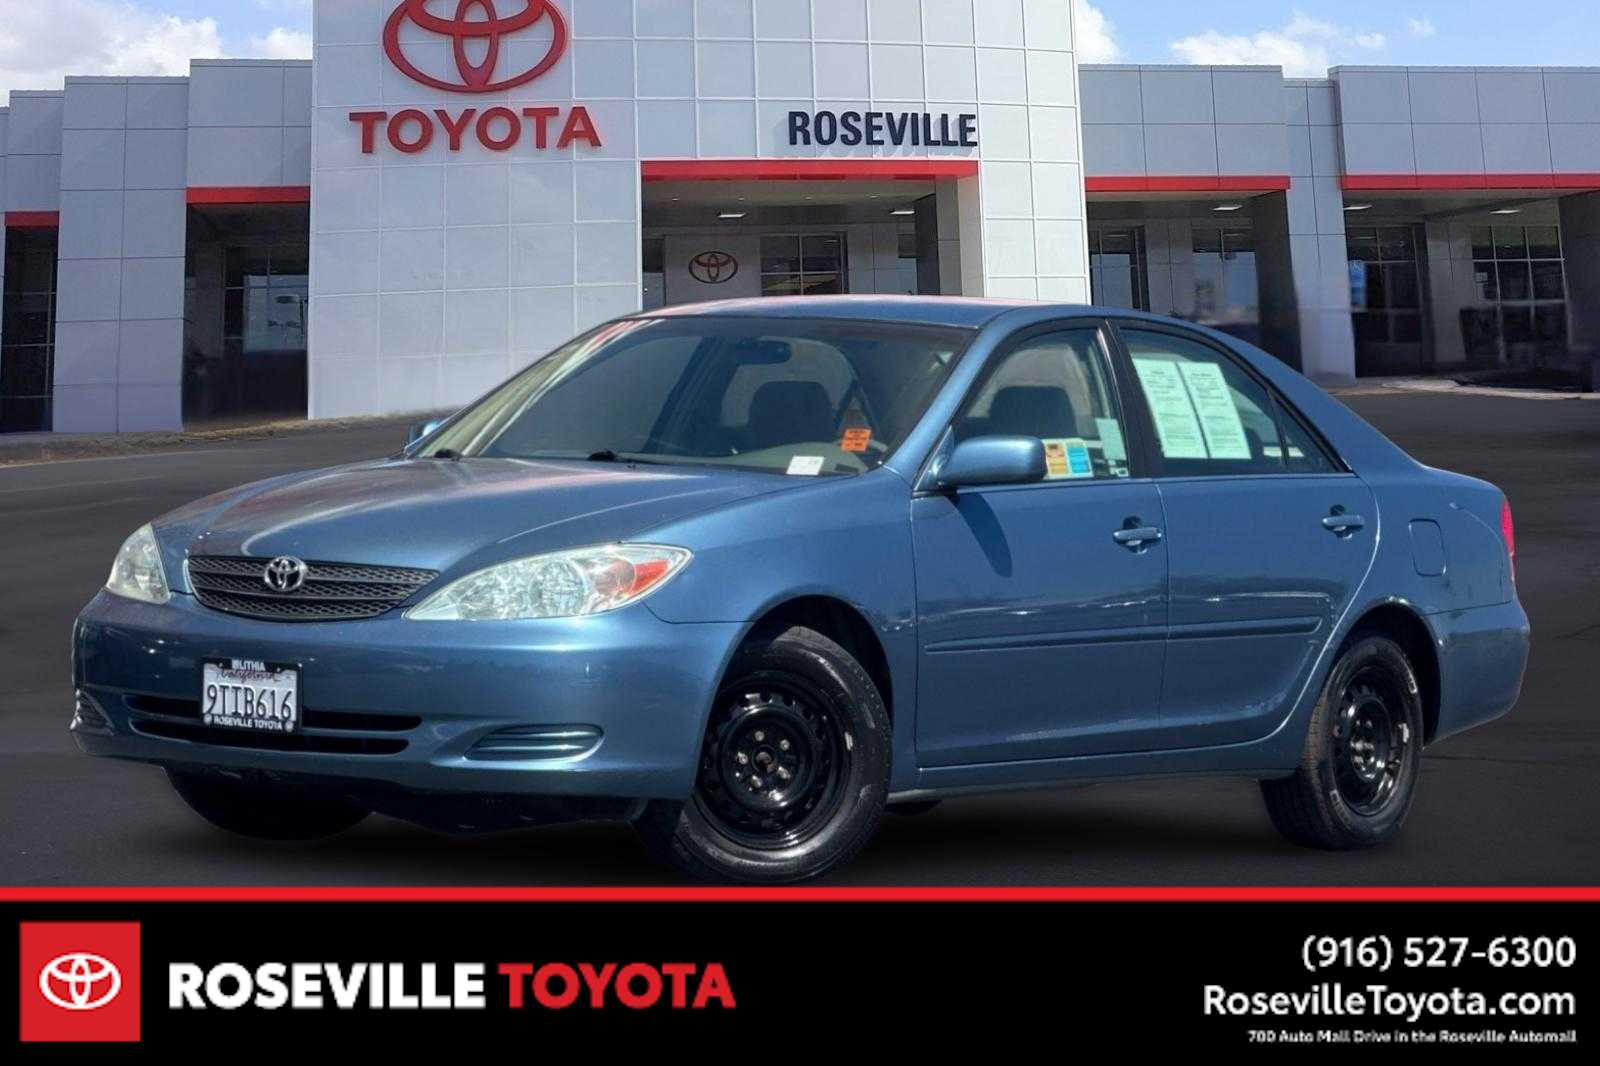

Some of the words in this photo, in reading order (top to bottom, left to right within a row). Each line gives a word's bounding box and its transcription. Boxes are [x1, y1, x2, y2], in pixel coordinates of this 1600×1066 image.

[349, 105, 602, 153] TOYOTA
[788, 110, 979, 148] ROSEVILLE
[240, 660, 266, 672] LITHIA
[214, 715, 253, 728] ROSEVILLE
[254, 719, 283, 730] TOYOTA
